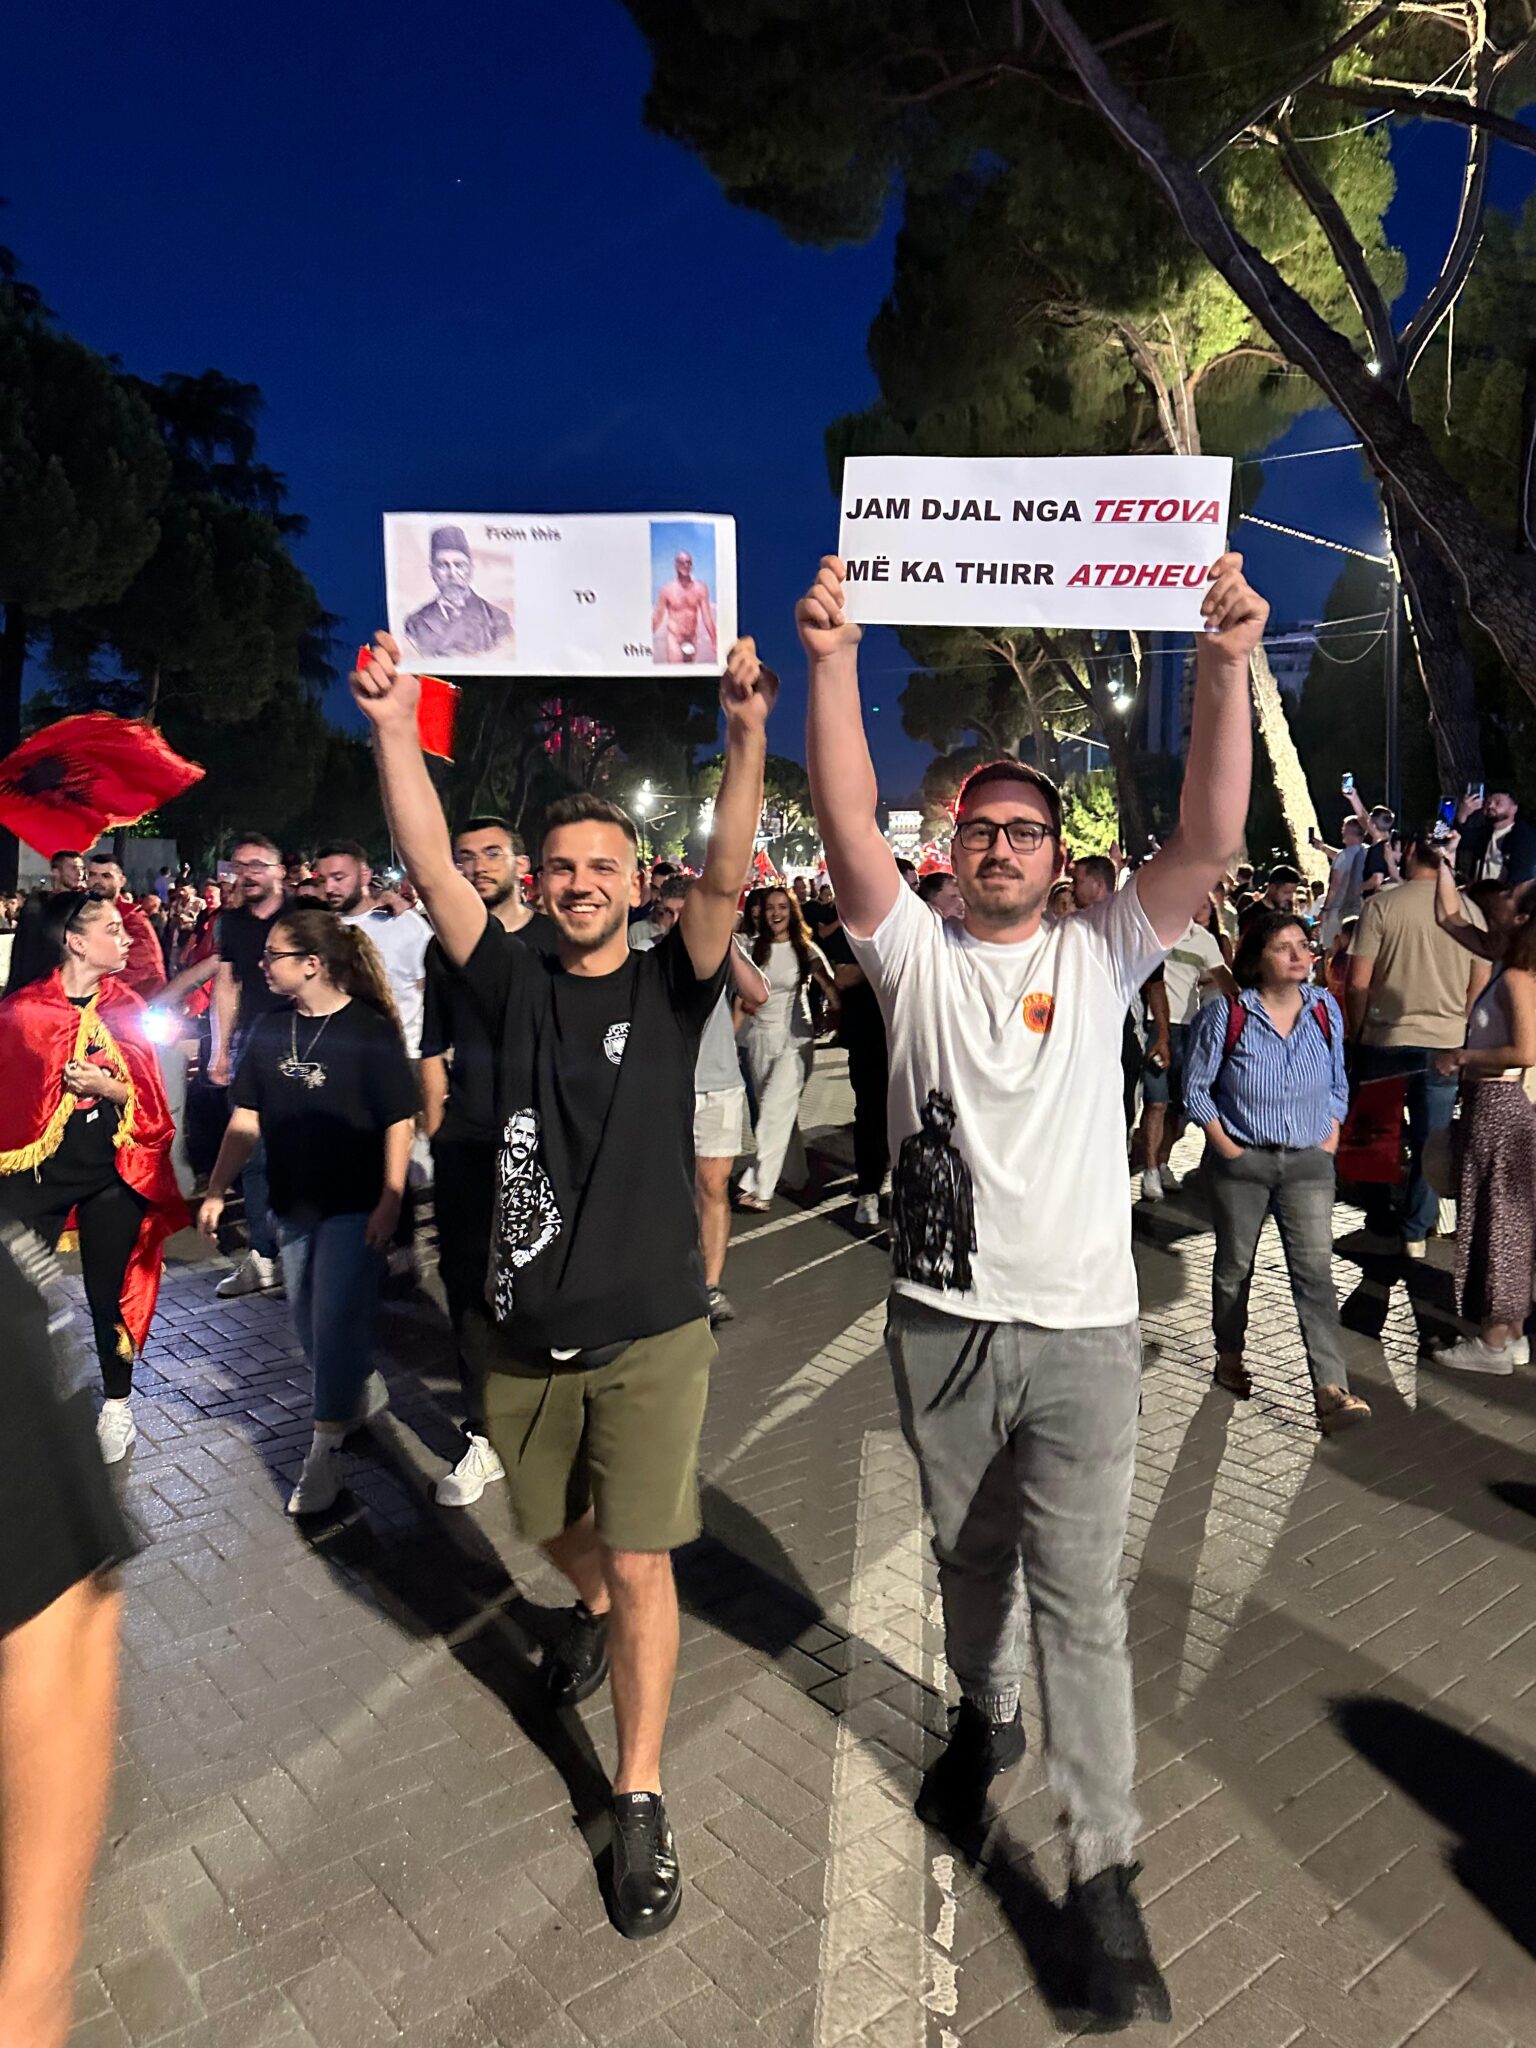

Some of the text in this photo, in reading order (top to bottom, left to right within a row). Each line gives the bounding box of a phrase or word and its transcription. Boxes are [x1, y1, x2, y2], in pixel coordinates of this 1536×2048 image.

[846, 498, 1220, 524] JAM DJAL NGA TETOVA
[531, 524, 562, 541] this
[845, 555, 1209, 589] MË KA THIRR ATDHEU
[623, 642, 654, 657] this
